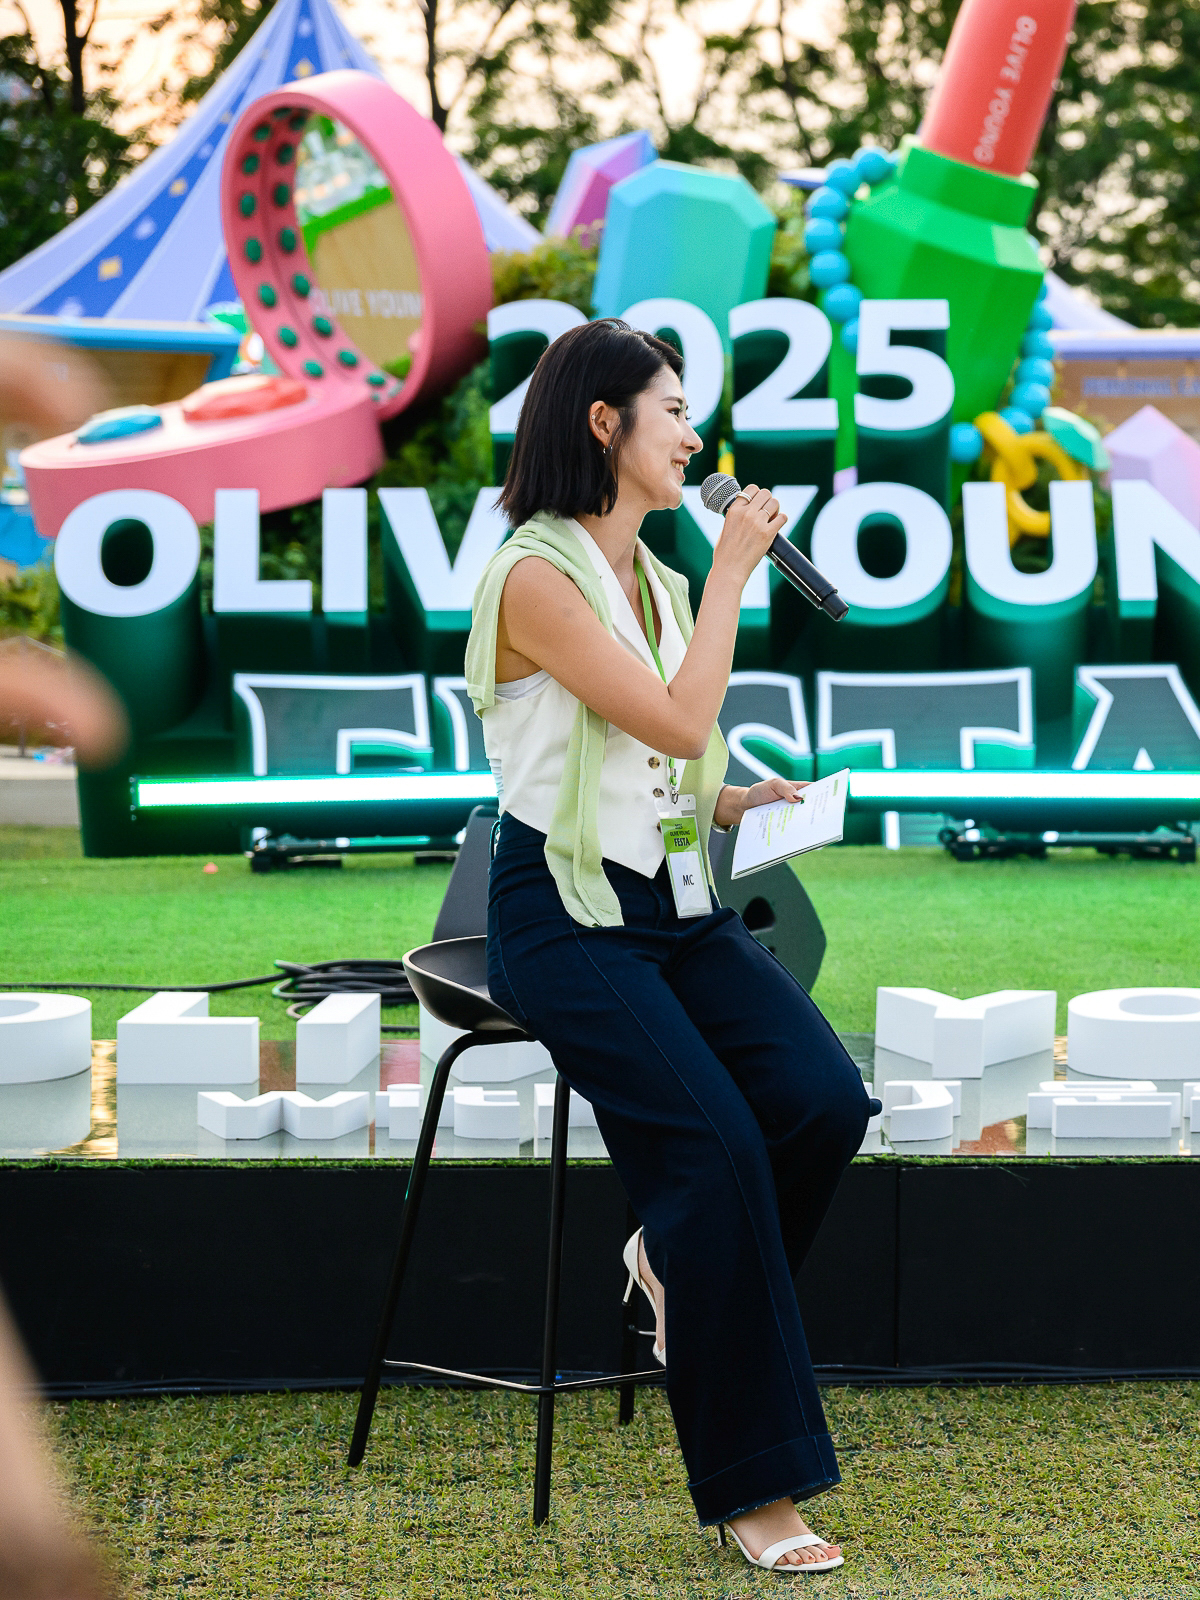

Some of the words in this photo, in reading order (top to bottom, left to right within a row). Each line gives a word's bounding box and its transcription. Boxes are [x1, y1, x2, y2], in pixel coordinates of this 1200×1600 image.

[487, 298, 955, 431] 2025
[54, 487, 510, 617] OLIV
[674, 837, 690, 847] FESTA
[682, 874, 694, 886] MC
